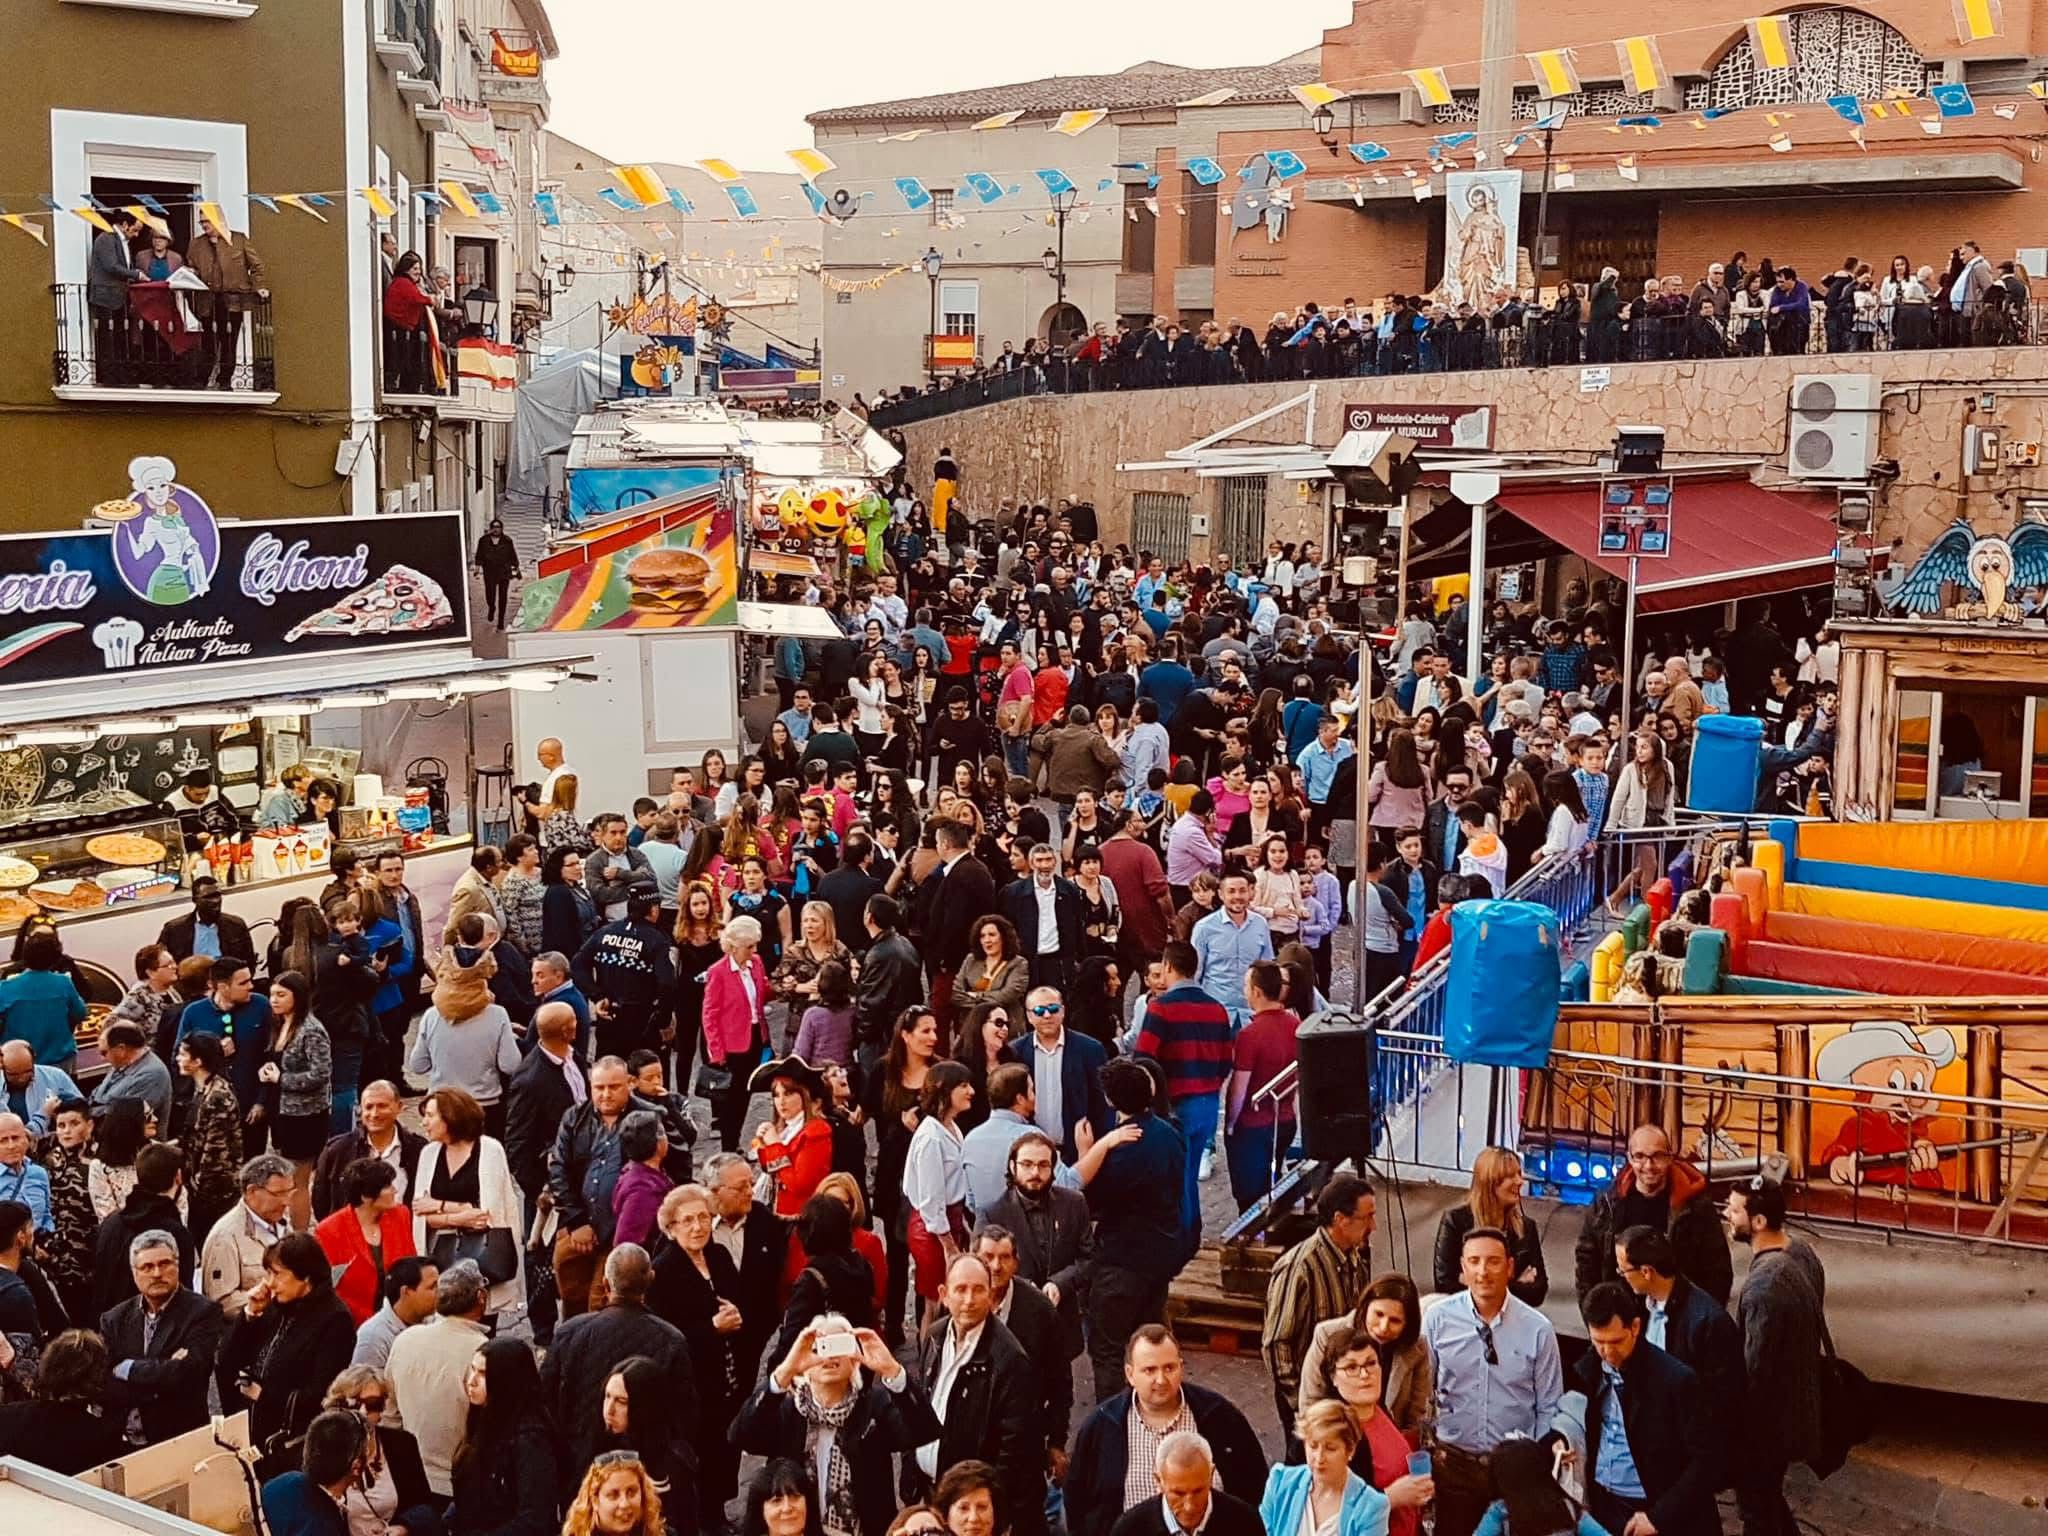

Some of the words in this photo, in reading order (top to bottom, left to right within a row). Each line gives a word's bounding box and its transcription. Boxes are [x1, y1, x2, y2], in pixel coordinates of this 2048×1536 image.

[1397, 426, 1438, 438] MURALLA
[240, 532, 369, 607] Choni
[150, 615, 234, 642] Authentic
[139, 642, 196, 664] Italian
[200, 637, 252, 662] Pizza
[602, 934, 643, 952] POLICIA
[620, 949, 640, 959] LOCAL
